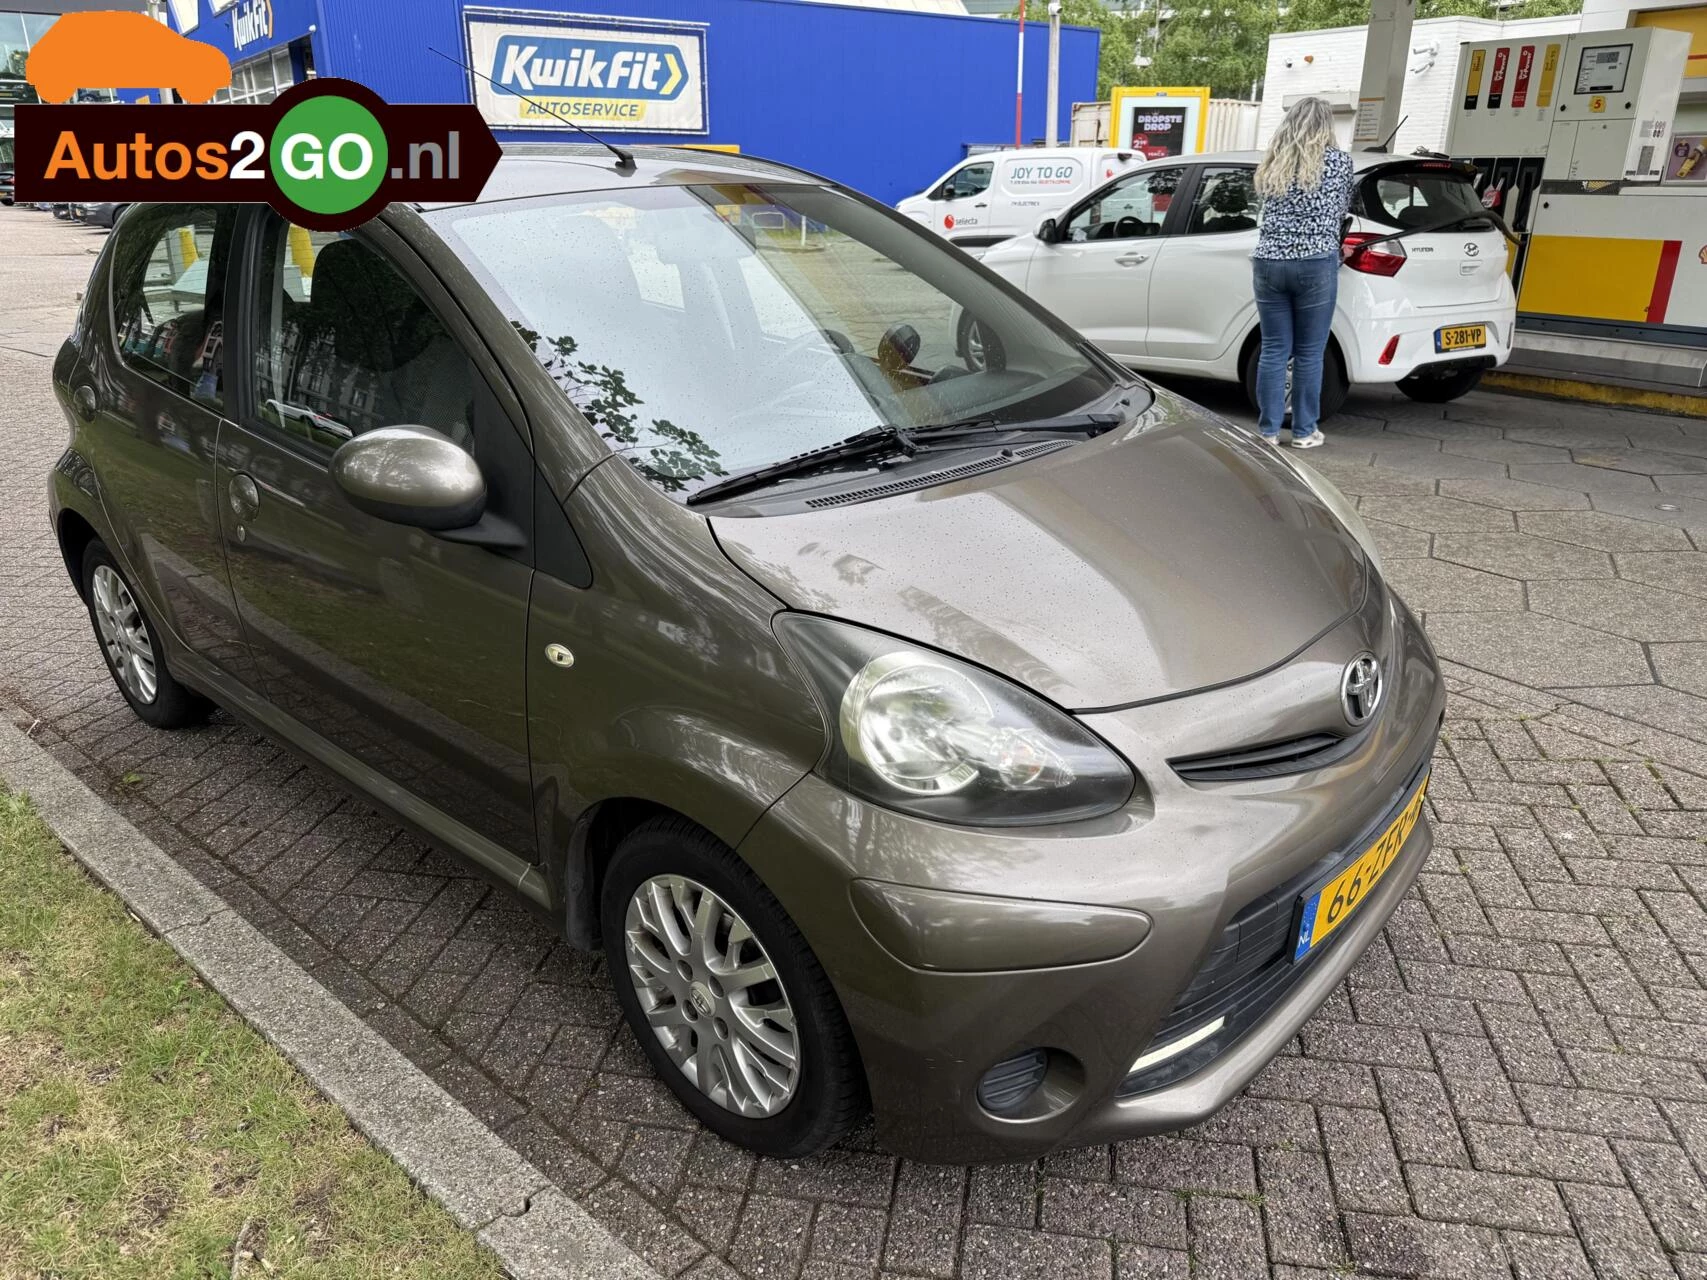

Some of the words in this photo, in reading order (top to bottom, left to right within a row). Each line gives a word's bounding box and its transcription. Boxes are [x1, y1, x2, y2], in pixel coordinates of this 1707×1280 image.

[1521, 51, 1532, 79] V-Power
[526, 101, 639, 117] AUTOSERVICE
[1594, 98, 1602, 110] 5
[1137, 114, 1183, 123] DROPSTE
[1143, 123, 1172, 131] DROP
[1011, 167, 1033, 179] JOY
[1037, 166, 1053, 178] TO
[1055, 166, 1073, 178] GO
[956, 217, 978, 225] selecta
[1445, 329, 1481, 345] S-281-VP
[1298, 929, 1311, 947] NL
